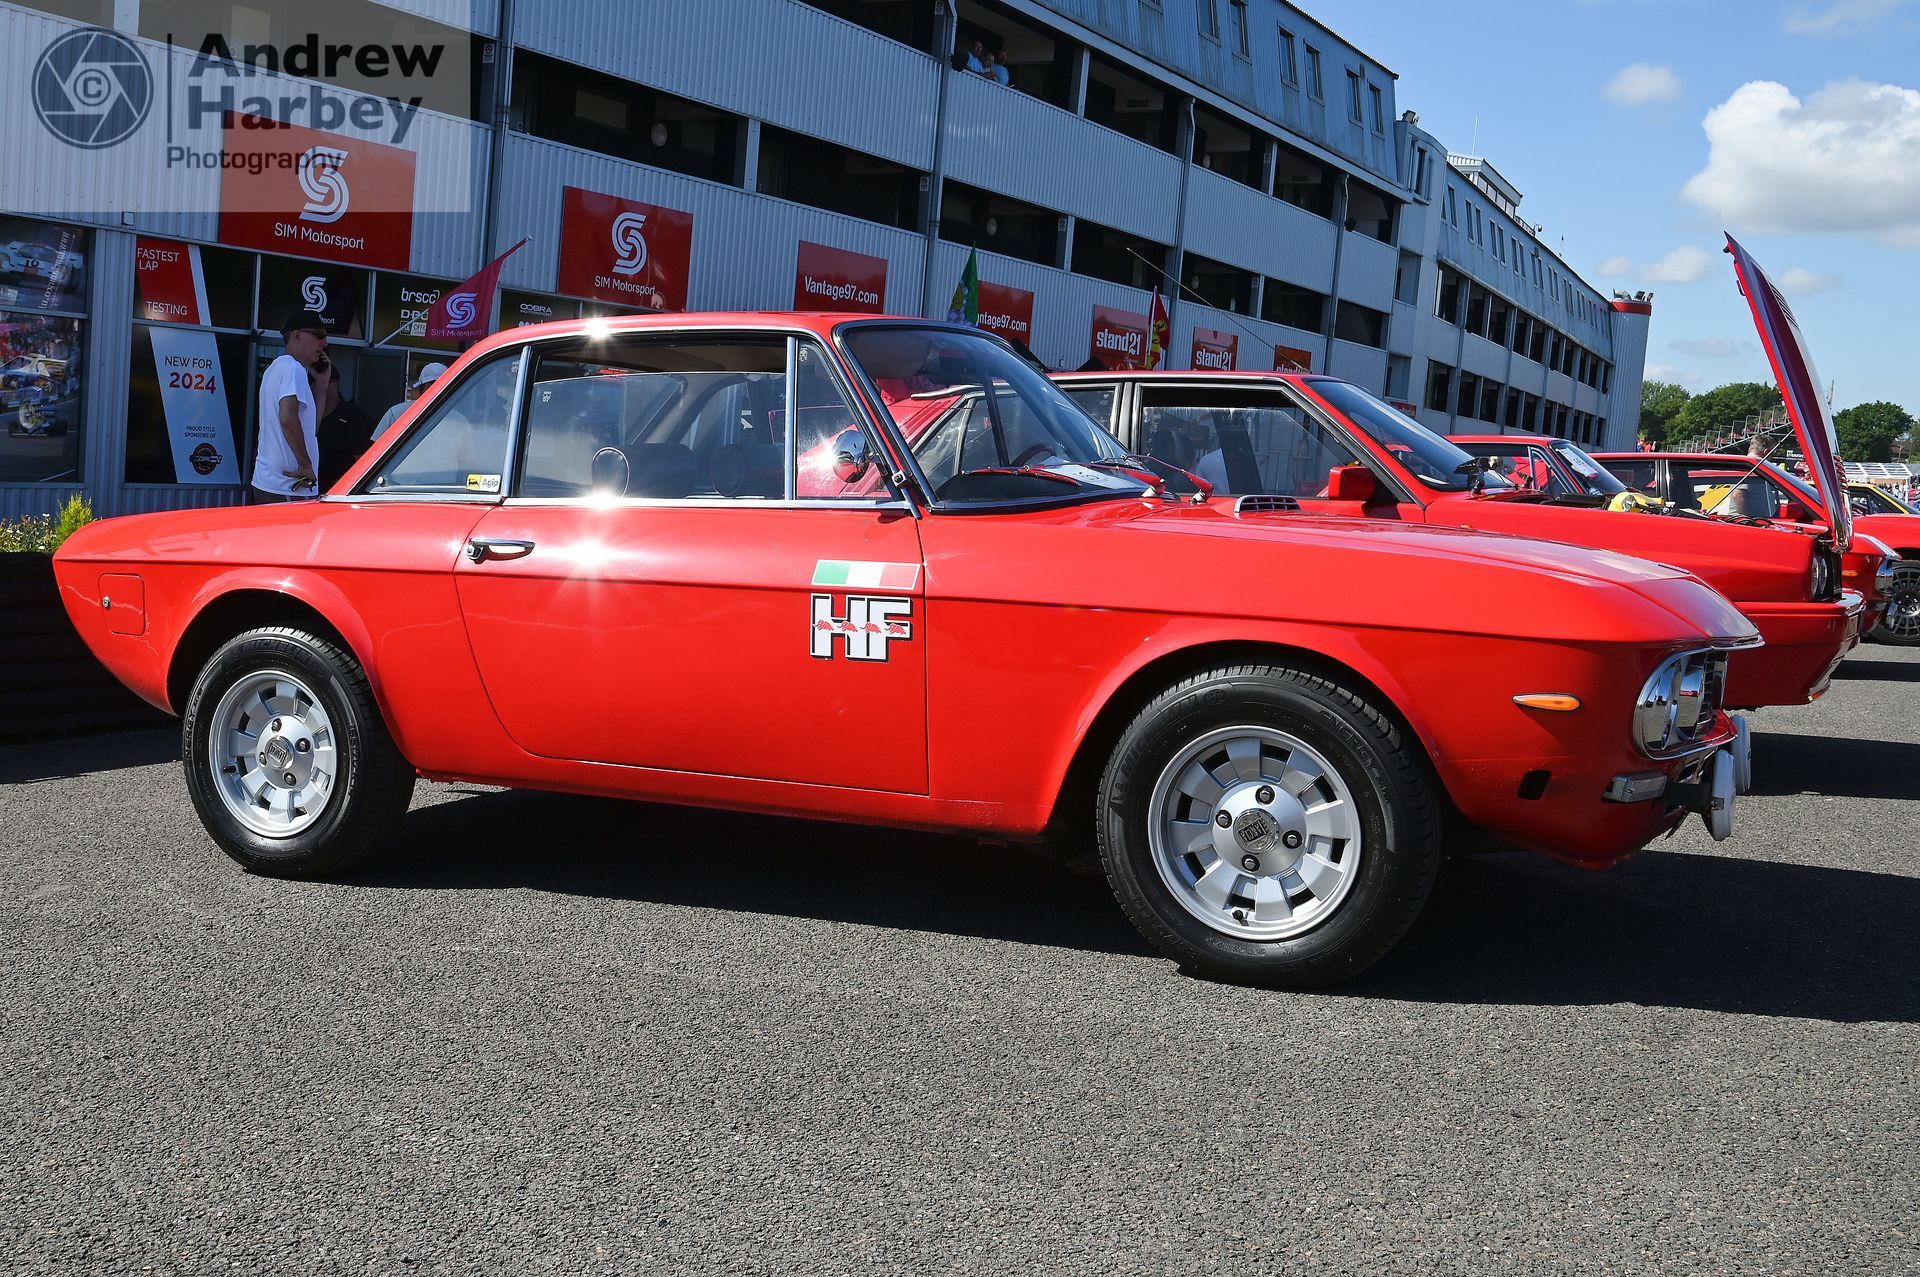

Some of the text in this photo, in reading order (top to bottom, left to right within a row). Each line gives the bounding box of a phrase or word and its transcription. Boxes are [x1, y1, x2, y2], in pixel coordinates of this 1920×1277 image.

[274, 222, 364, 250] SIM Motorsport
[137, 247, 179, 262] FASTEST
[139, 259, 159, 270] LAP
[594, 275, 656, 296] SIM Motorsport
[804, 275, 878, 304] Vantage97.com
[401, 287, 439, 304] brscc
[146, 300, 188, 316] TESTING
[520, 303, 552, 314] COBRA
[431, 328, 445, 336] SIM
[446, 329, 482, 337] Motorsport
[1096, 328, 1141, 355] stand21
[164, 355, 213, 370] NEW FOR
[1195, 348, 1232, 371] stand21
[168, 371, 216, 394] 2024
[482, 478, 499, 488] Agip
[810, 593, 913, 663] HF
[1318, 710, 1378, 770] ENERGY
